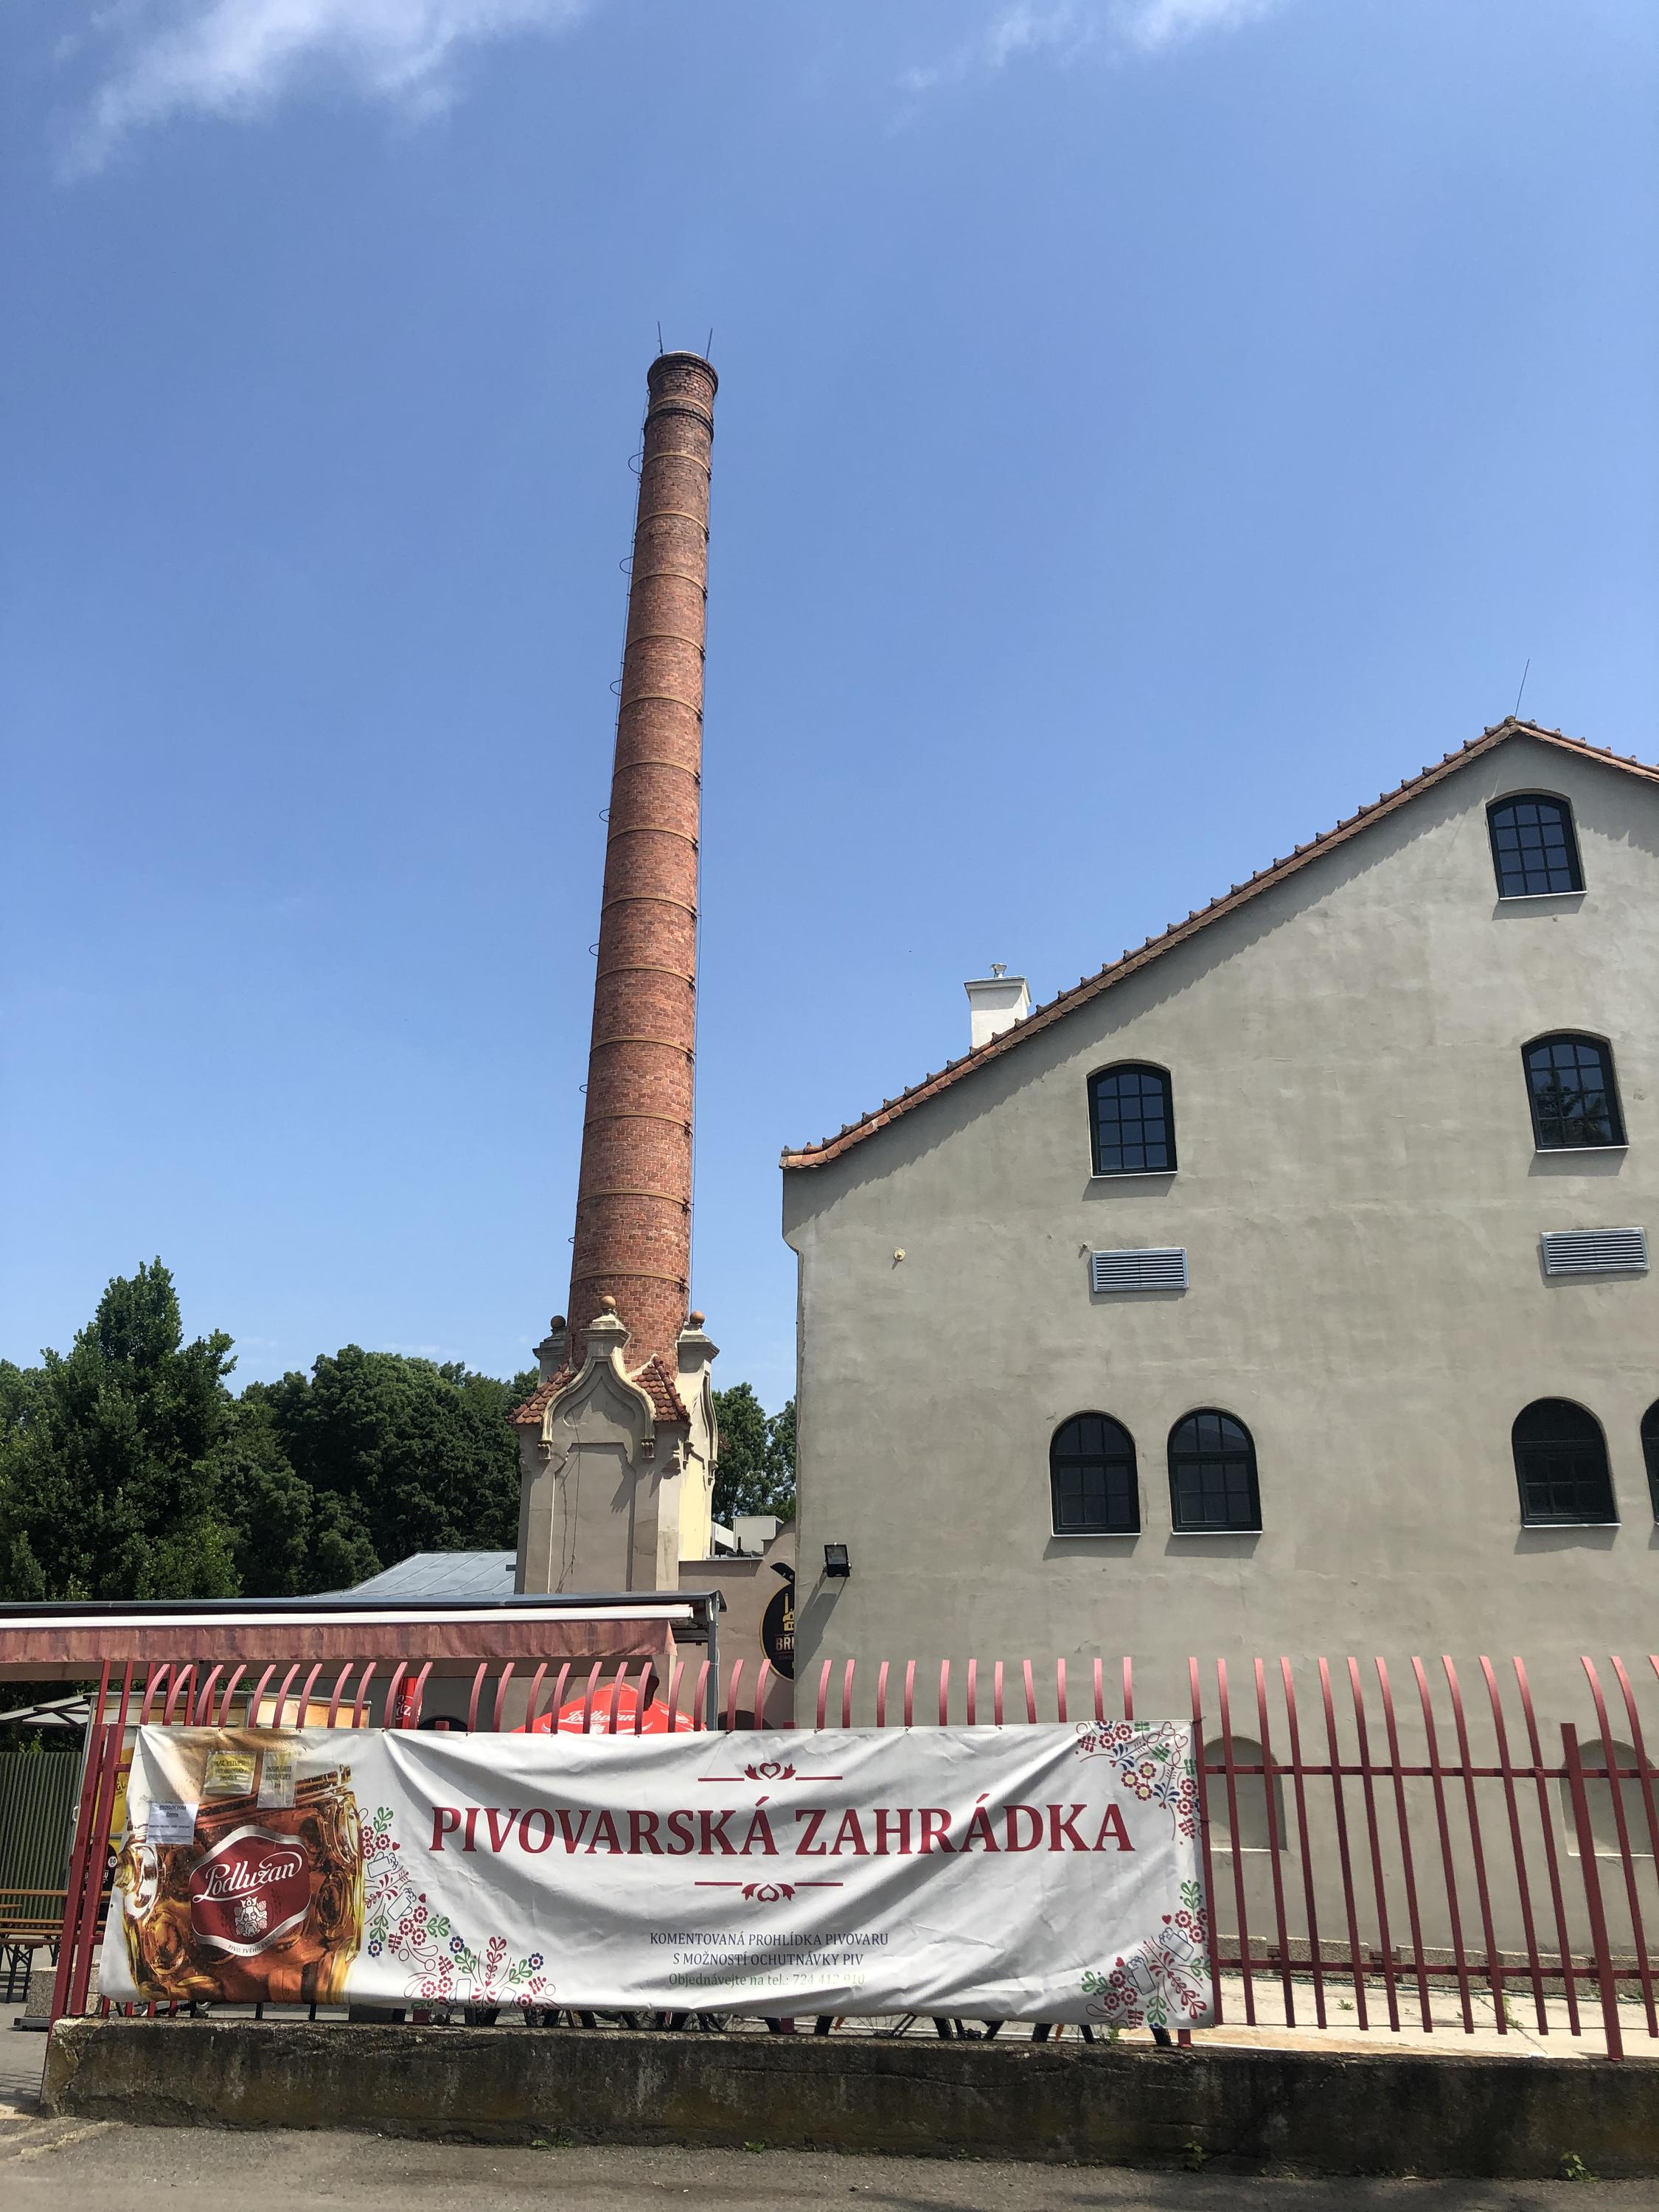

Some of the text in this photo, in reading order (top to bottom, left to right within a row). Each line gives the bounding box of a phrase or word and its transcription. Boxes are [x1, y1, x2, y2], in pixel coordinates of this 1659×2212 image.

[428, 1793, 1135, 1856] PIVOVARSKÁ ZAHRÁDKA
[192, 1851, 302, 1903] Podlužan
[650, 1931, 888, 1946] KOMENTOVANÁ PROHLÍDKA PIVOVARU
[673, 1951, 863, 1966] S MOŽNOSTÍ OCHUTNÁVKY PIV
[669, 1973, 747, 1988] Objednávejte
[750, 1976, 764, 1985] na
[768, 1973, 789, 1985] tel.:
[793, 1974, 814, 1985] 724
